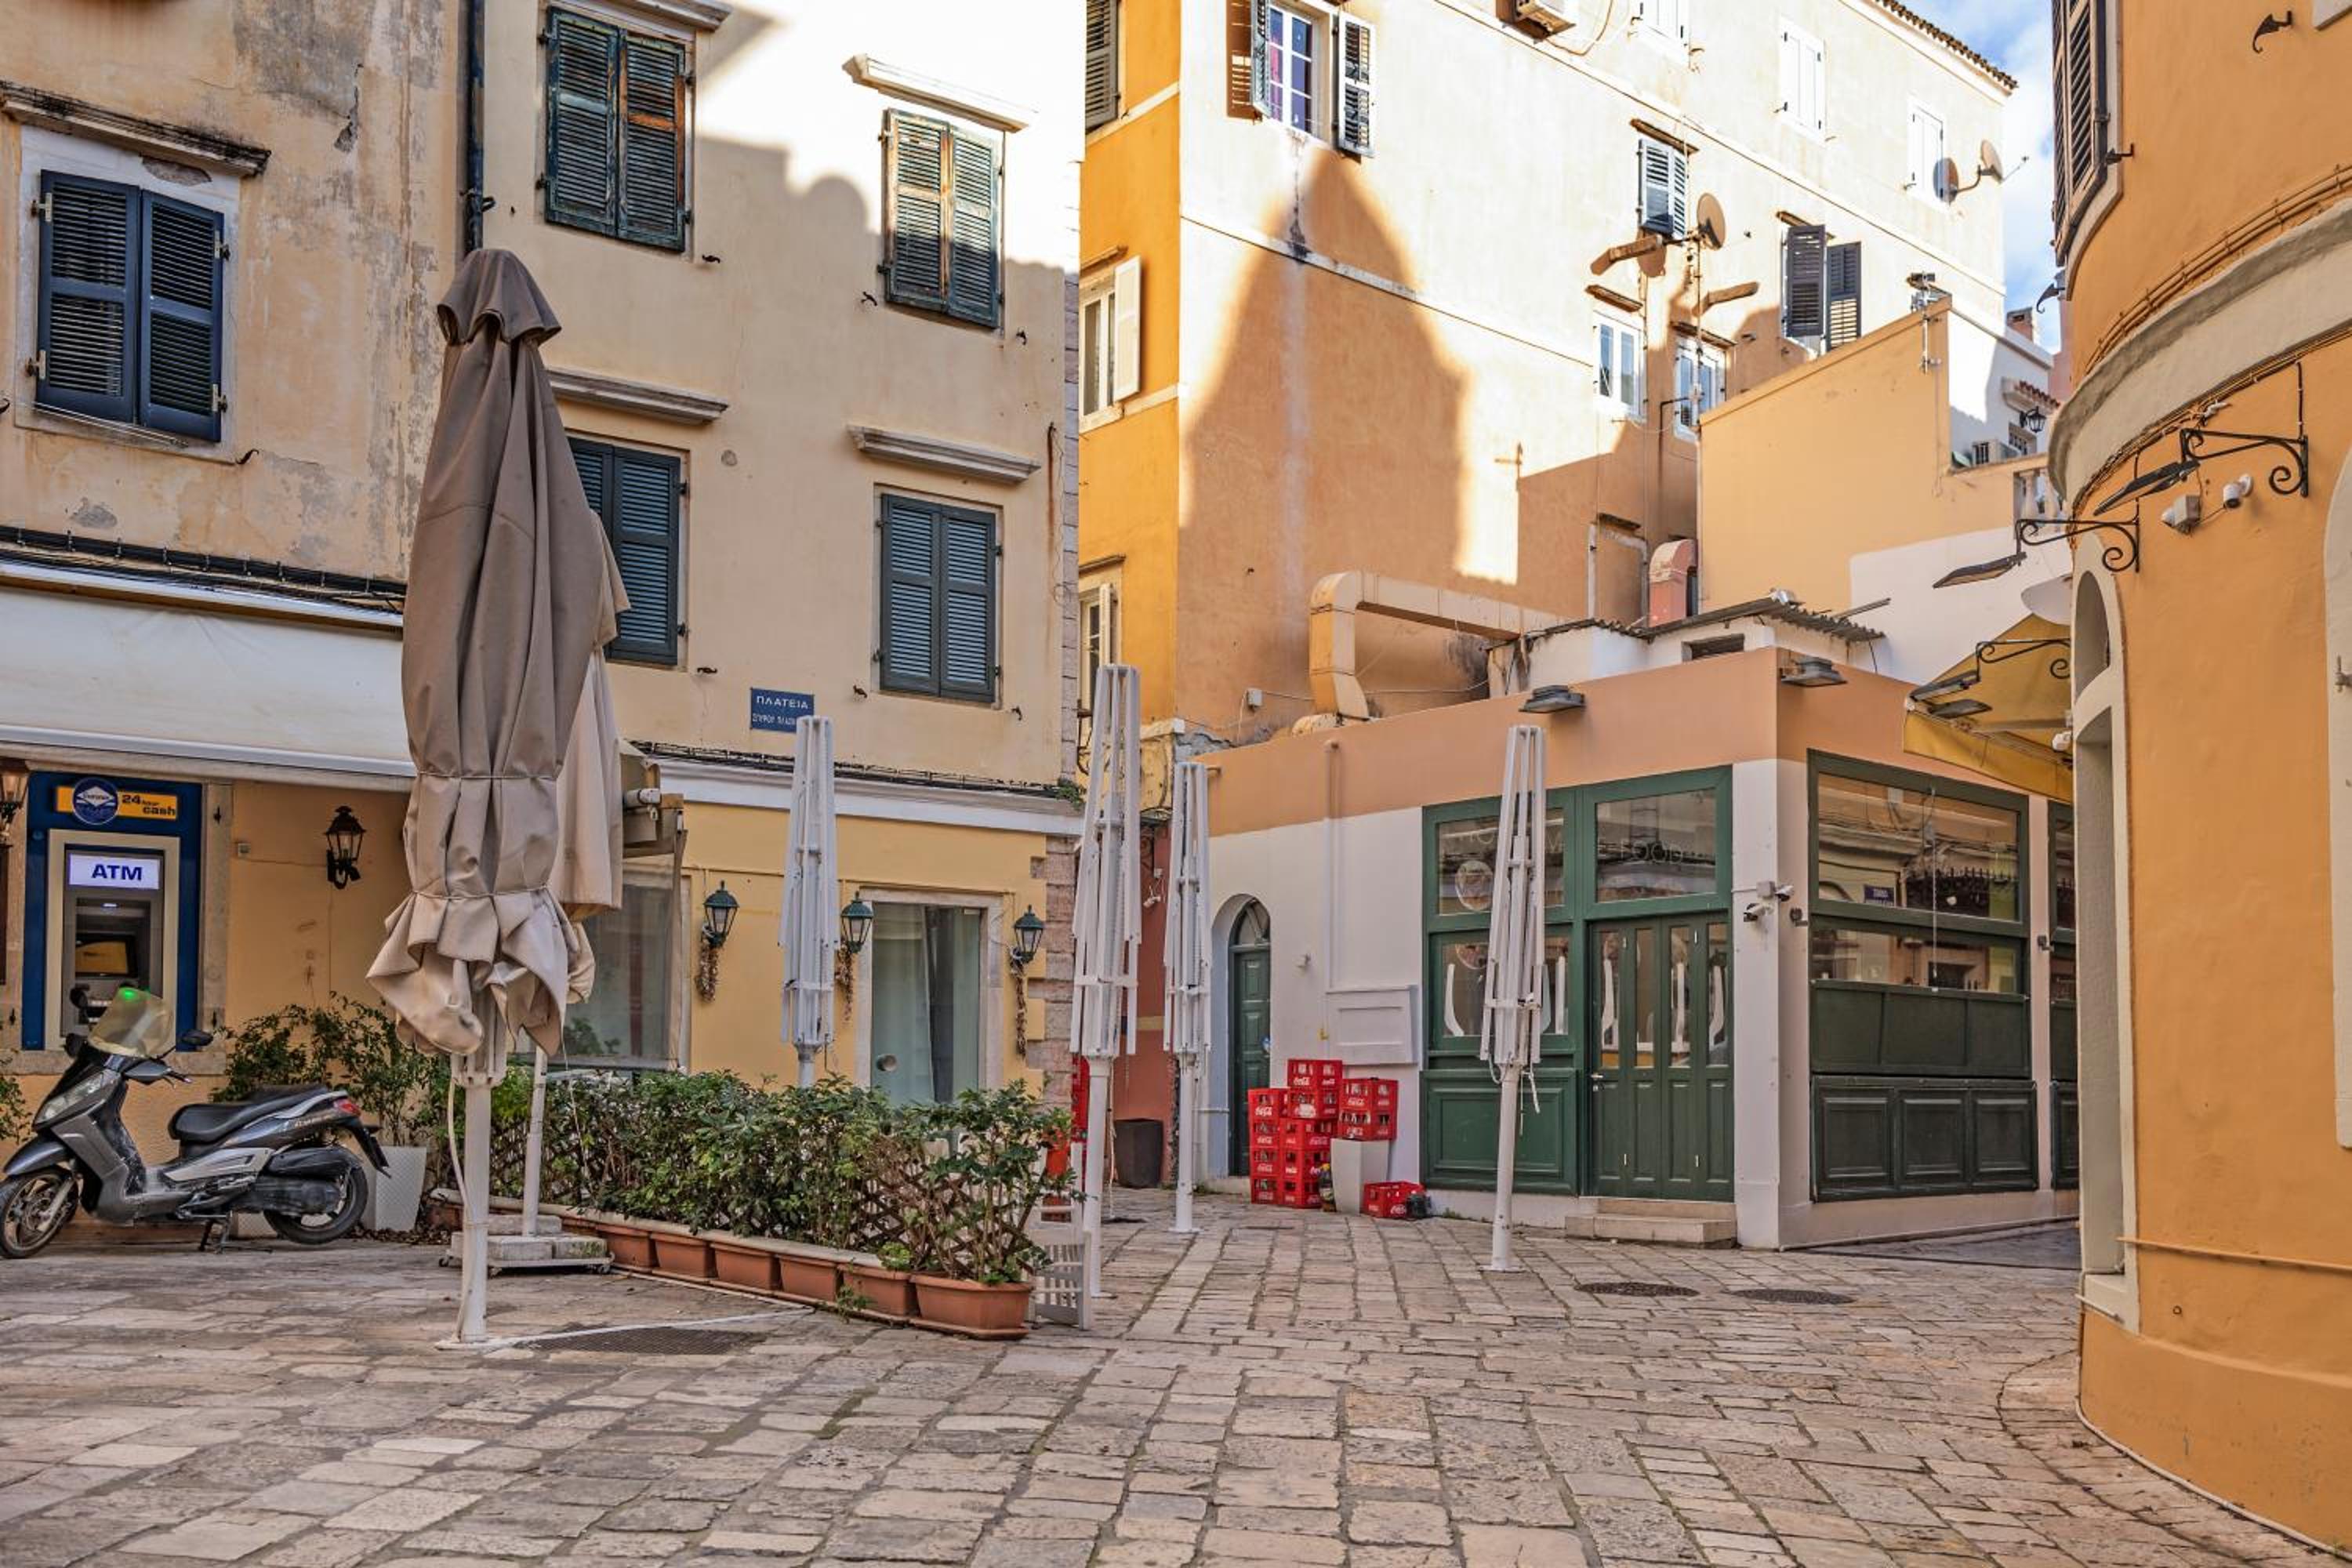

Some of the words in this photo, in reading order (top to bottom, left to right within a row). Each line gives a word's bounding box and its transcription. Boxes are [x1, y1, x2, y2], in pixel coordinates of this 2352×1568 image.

[757, 695, 808, 710] ΠΛΑΤΕΙΑ
[122, 794, 141, 804] 24
[143, 805, 176, 816] cash
[91, 864, 143, 881] ATM
